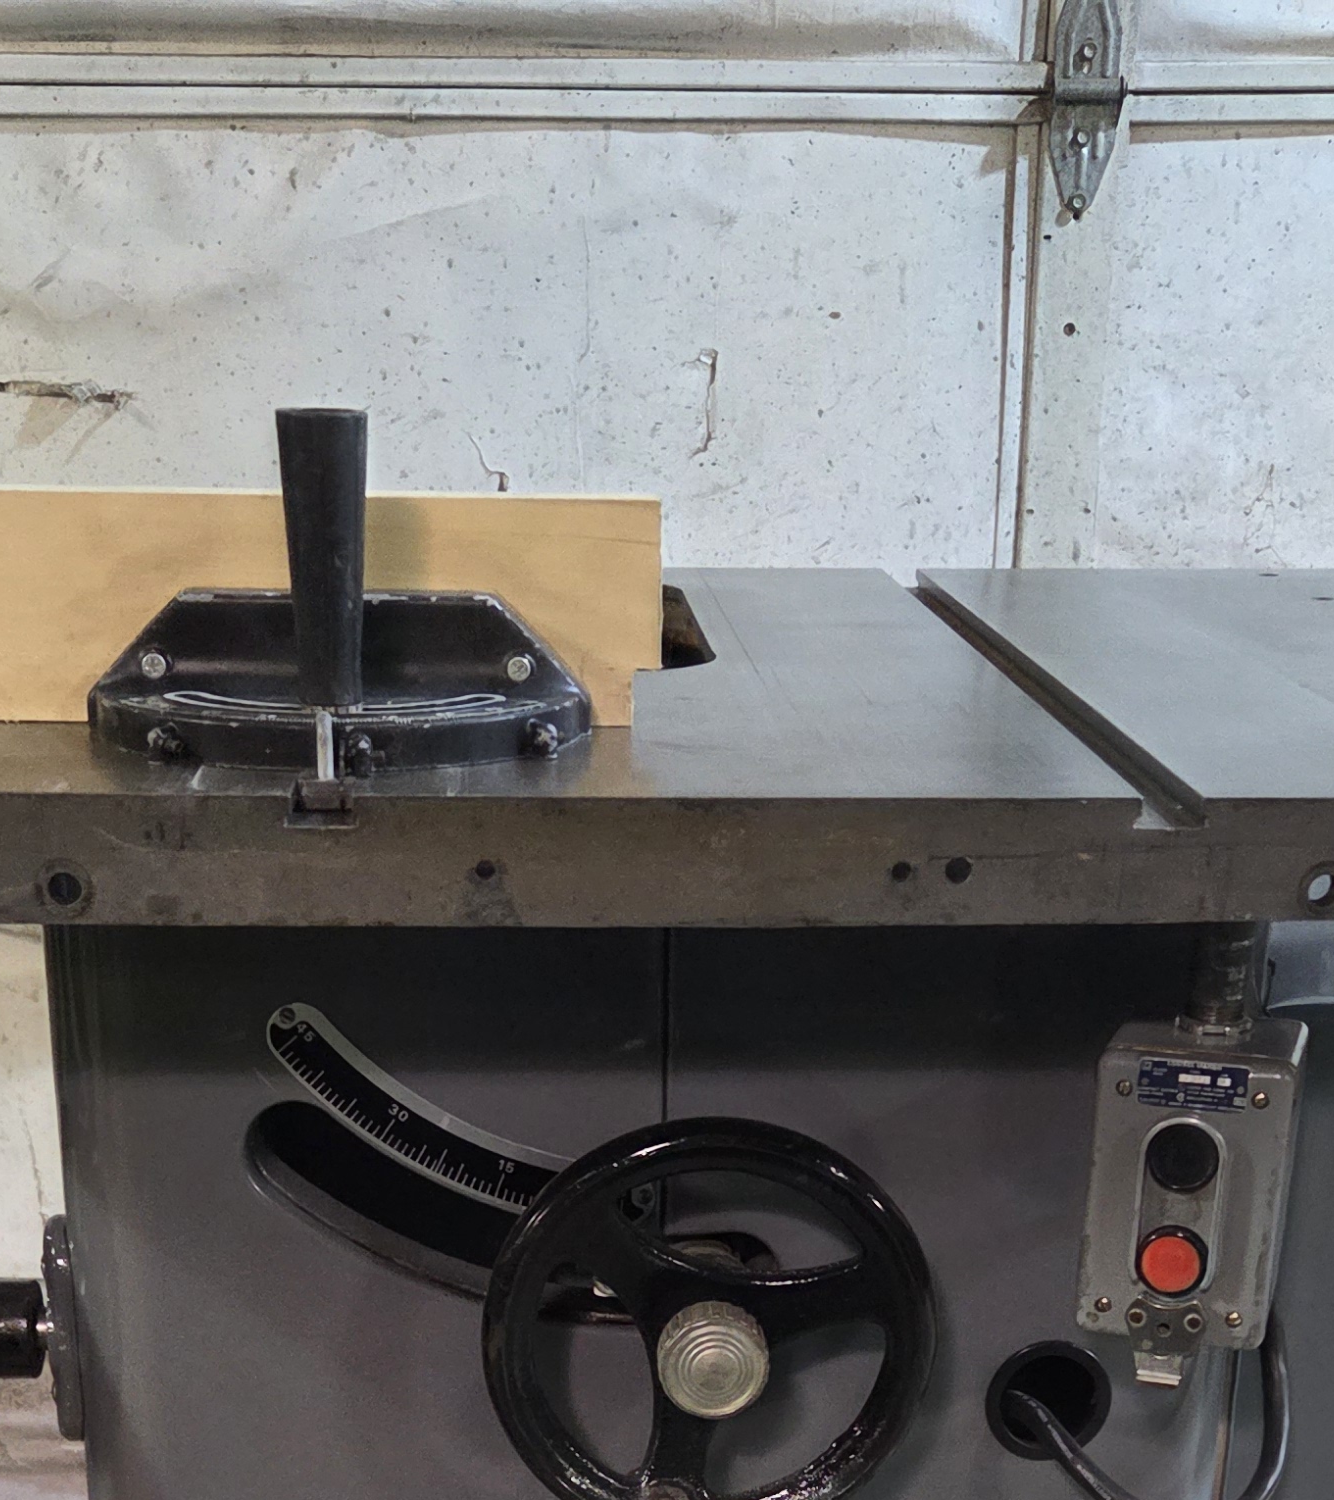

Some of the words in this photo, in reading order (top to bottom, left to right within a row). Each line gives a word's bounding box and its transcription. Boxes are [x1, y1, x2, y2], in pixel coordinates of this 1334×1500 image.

[295, 1022, 316, 1042] 45
[388, 1103, 409, 1122] 30
[498, 1159, 514, 1174] 15
